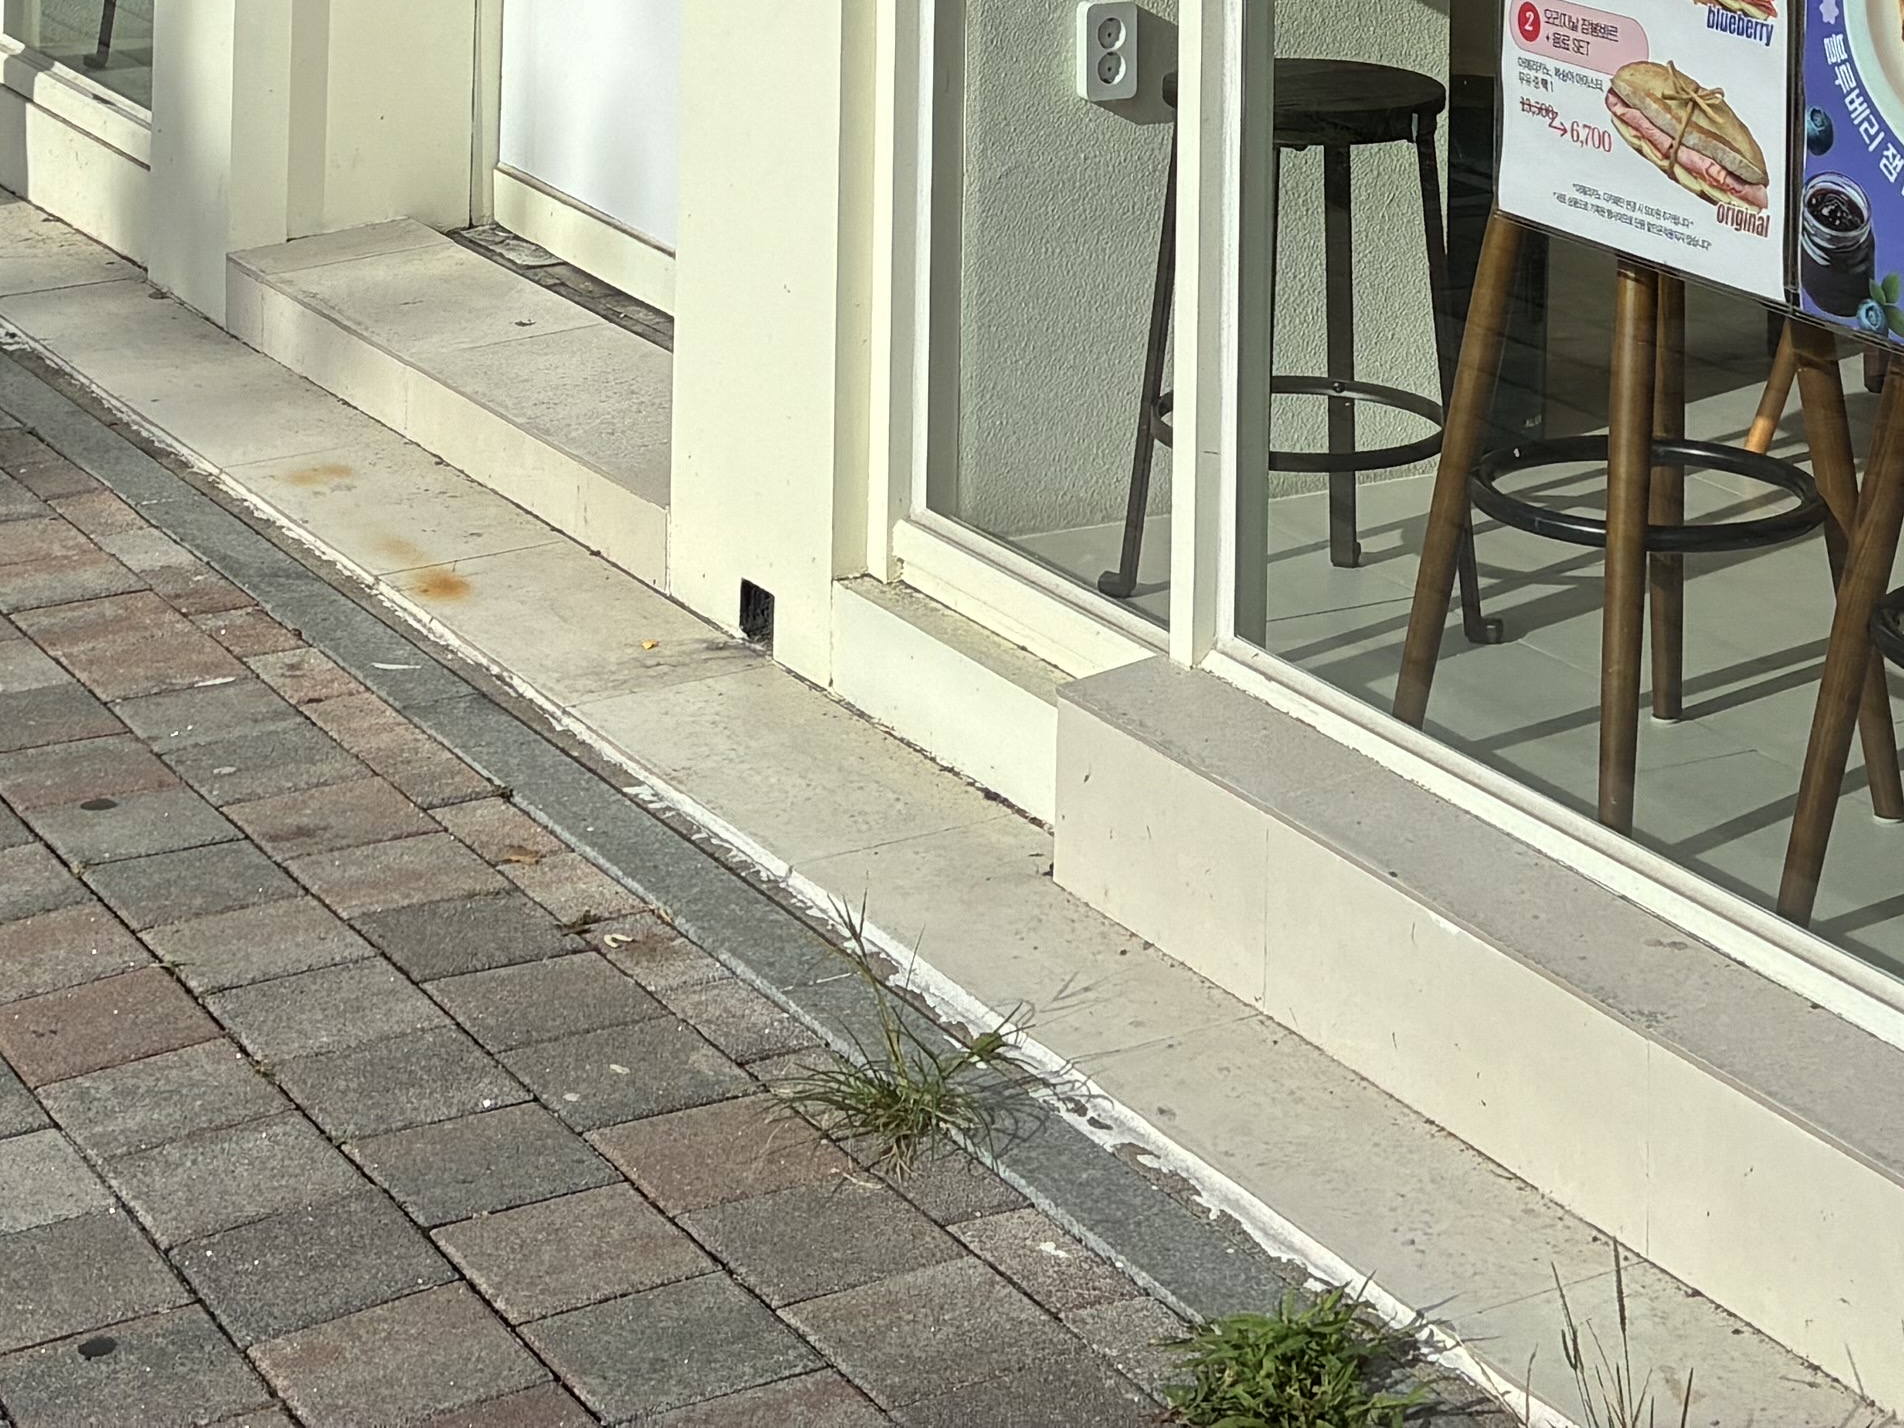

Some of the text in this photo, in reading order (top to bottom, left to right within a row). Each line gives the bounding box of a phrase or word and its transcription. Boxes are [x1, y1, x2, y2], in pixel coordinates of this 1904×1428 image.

[1543, 8, 1579, 33] 오리지널
[1706, 4, 1774, 47] blueberry
[1571, 38, 1591, 57] SET
[1823, 32, 1886, 153] 블루베리
[1570, 120, 1613, 153] 6,700
[1716, 202, 1771, 239] original
